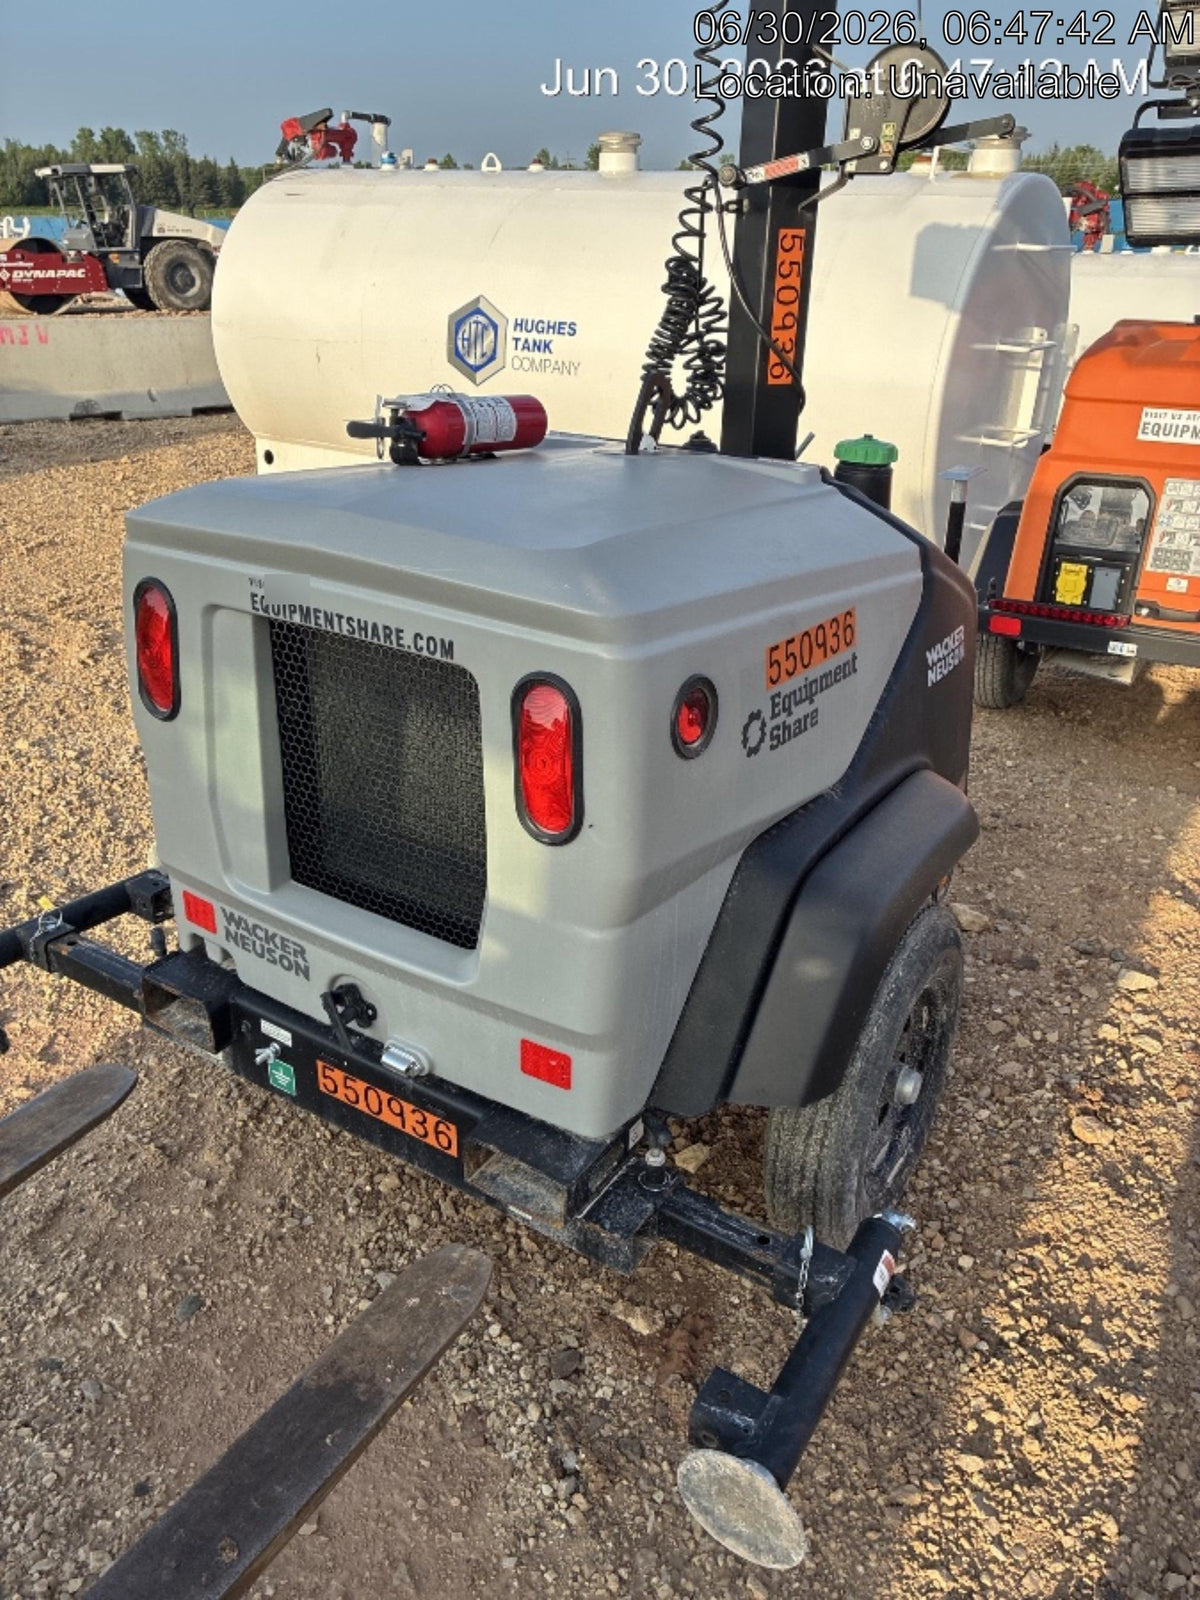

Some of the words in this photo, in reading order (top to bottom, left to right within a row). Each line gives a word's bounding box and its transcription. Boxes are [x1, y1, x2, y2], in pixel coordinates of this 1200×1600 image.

[12, 269, 86, 279] DYNAPAC
[513, 318, 577, 337] HUGHES
[768, 232, 805, 380] 550936
[511, 355, 581, 376] COMPANY
[512, 337, 554, 354] TANK
[250, 591, 455, 661] EQUIPMENTSHARE.COM
[768, 610, 856, 686] 550936
[926, 624, 964, 667] WACKER
[769, 651, 858, 720] Equipment
[927, 641, 964, 687] NEUSON
[769, 707, 819, 751] Share
[220, 906, 309, 964] WACKER
[224, 925, 310, 982] NEUSON
[321, 1064, 453, 1151] 550936
